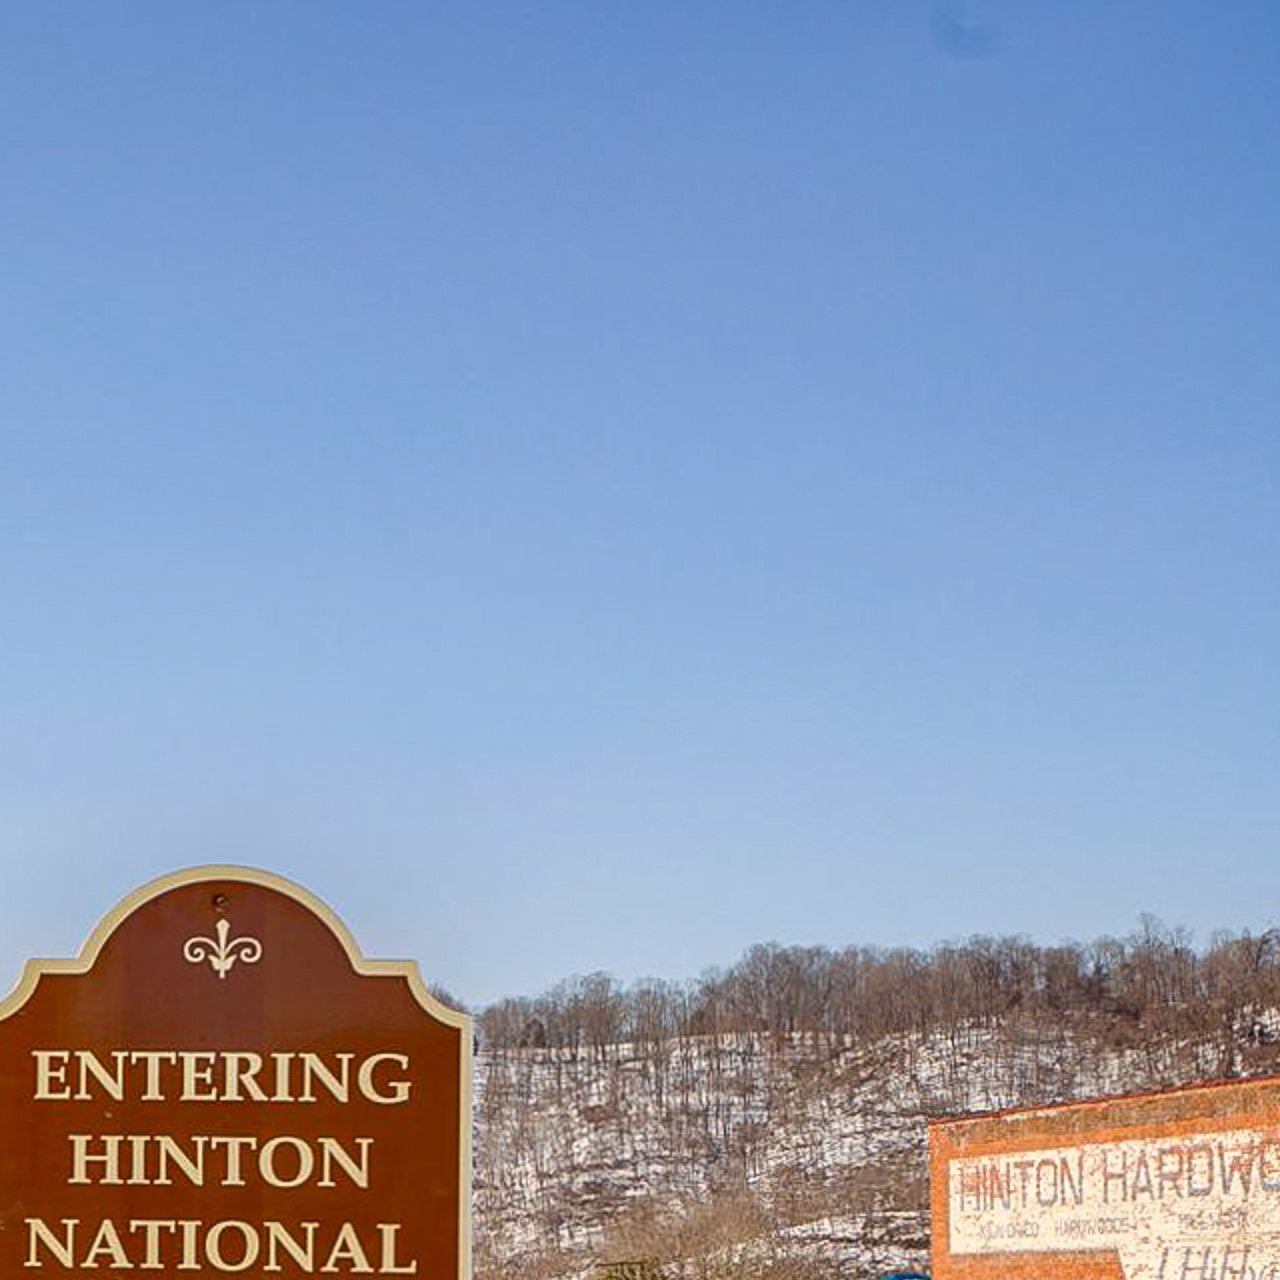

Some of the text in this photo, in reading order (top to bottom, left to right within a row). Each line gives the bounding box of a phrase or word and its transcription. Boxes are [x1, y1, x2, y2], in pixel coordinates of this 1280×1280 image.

[31, 1050, 412, 1104] ENTERING
[67, 1135, 374, 1188] HINTON
[959, 1152, 1083, 1212] HINTON
[23, 1218, 417, 1274] NATIONAL
